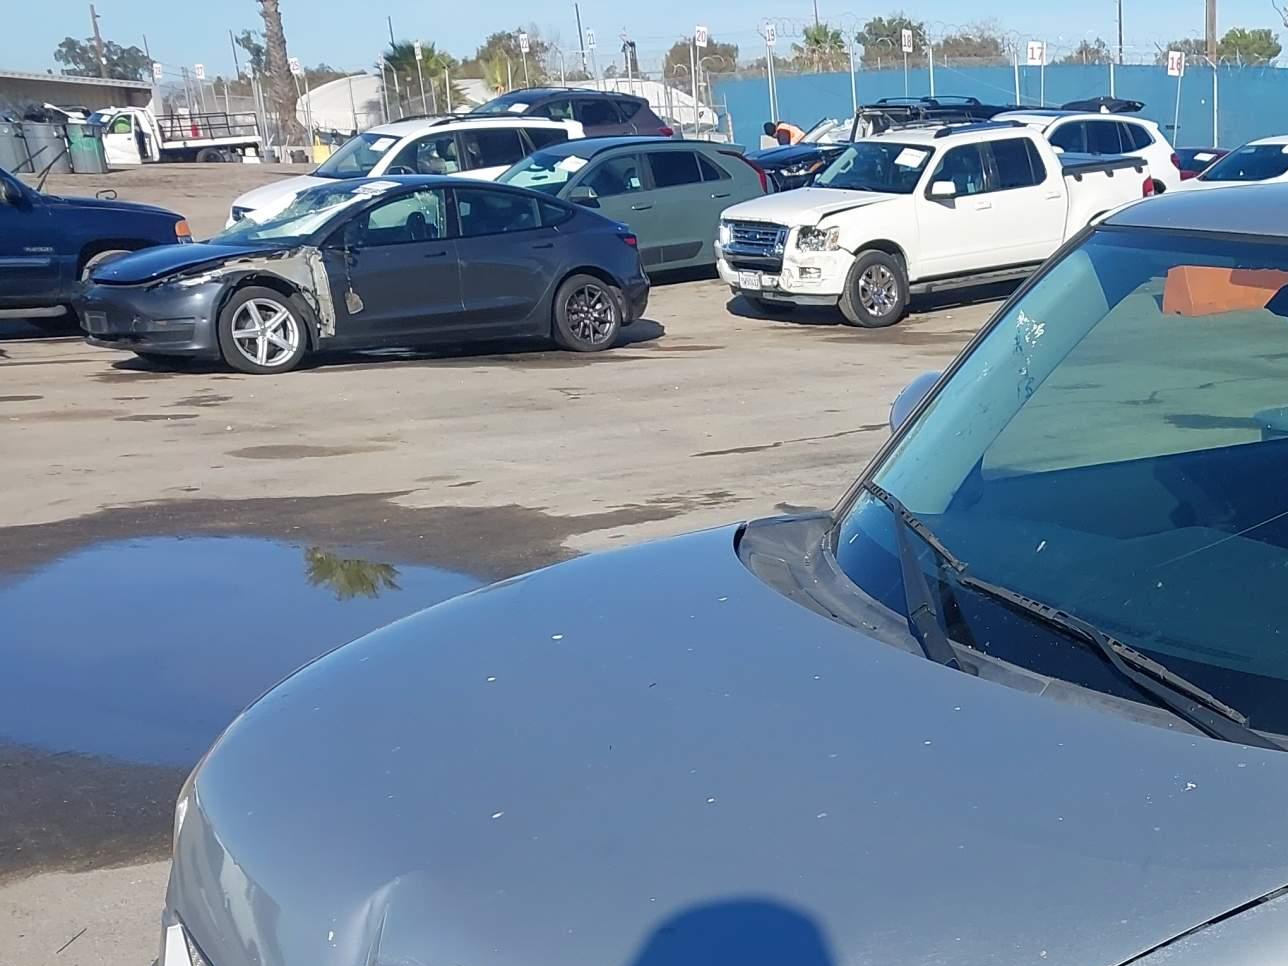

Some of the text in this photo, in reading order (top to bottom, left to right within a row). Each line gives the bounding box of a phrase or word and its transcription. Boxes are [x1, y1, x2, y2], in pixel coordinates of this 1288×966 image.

[696, 30, 706, 43] 20
[766, 28, 775, 41] 19
[903, 34, 912, 47] 18
